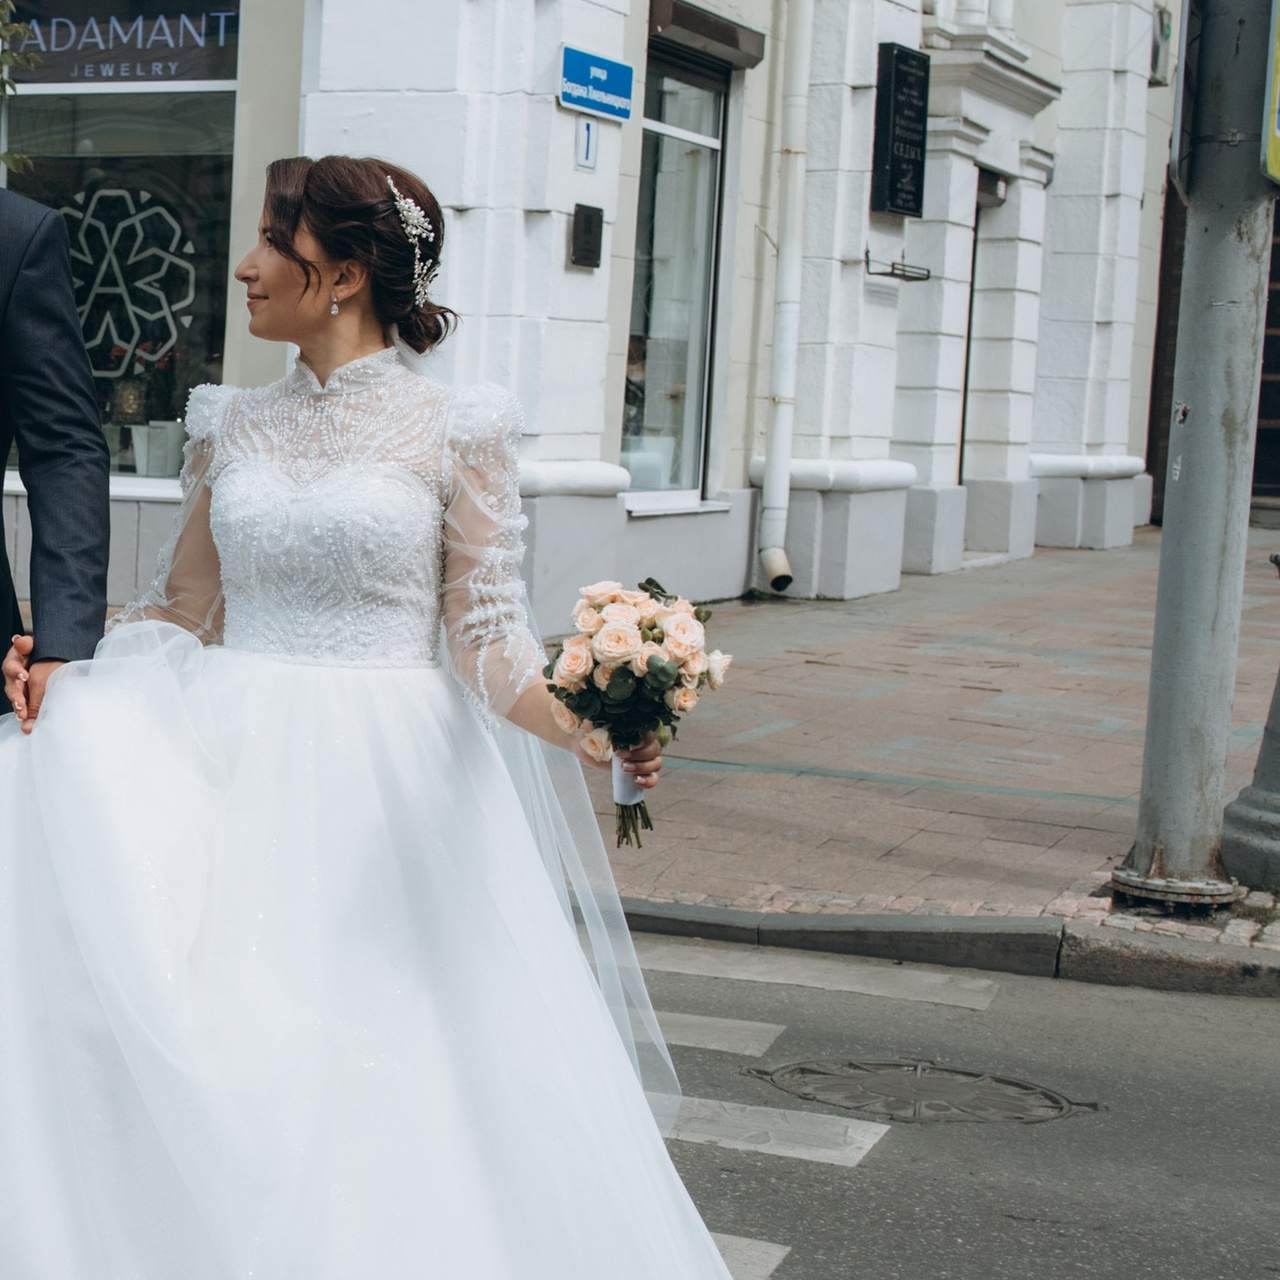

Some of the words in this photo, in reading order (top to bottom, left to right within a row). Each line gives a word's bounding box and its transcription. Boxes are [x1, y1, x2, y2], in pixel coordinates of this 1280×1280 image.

[19, 11, 236, 53] ADAMANT
[69, 62, 180, 78] JEWELRY
[585, 122, 591, 160] 1
